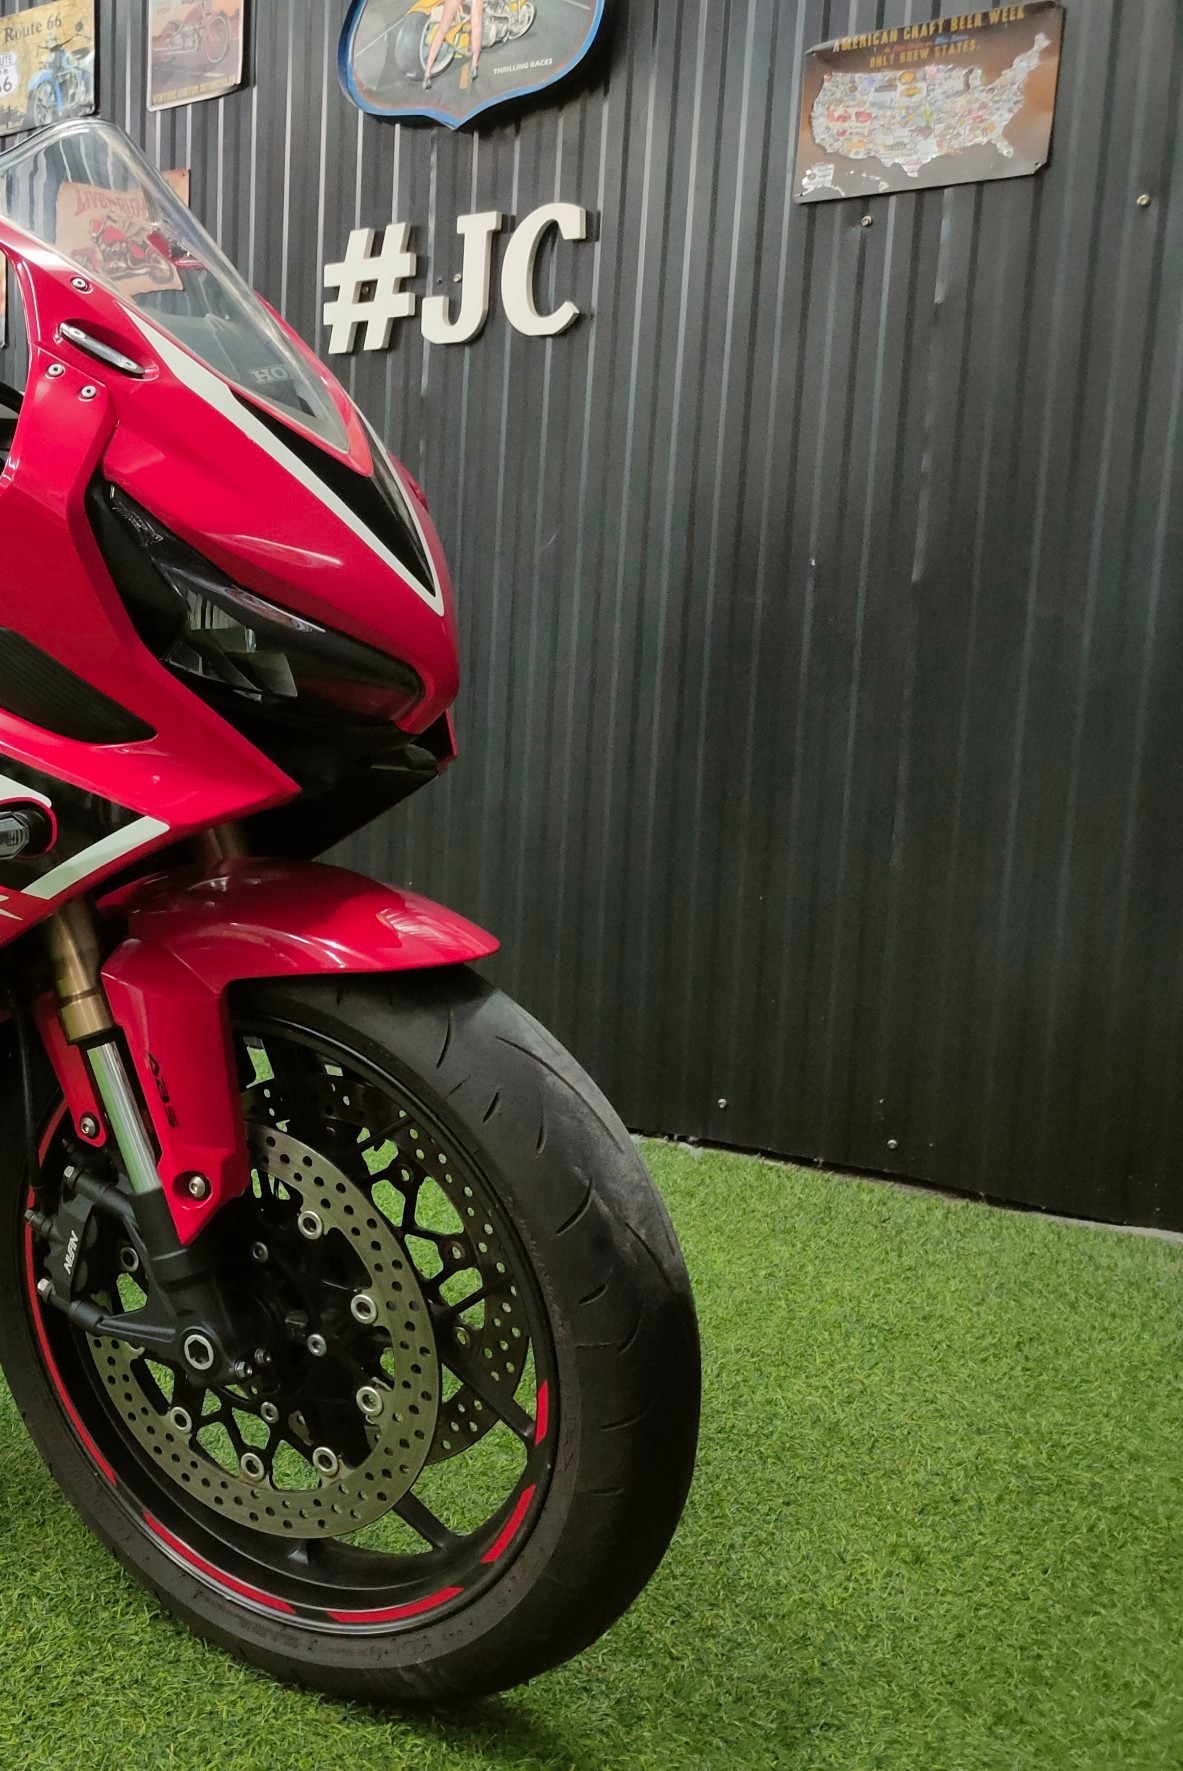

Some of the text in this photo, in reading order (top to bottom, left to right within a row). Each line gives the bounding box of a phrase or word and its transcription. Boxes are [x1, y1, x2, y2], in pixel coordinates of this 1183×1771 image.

[4, 21, 43, 43] Route
[46, 12, 62, 30] 66
[833, 28, 898, 53] AMERICAN
[903, 20, 945, 41] CRAFT
[950, 13, 982, 33] BEER
[989, 5, 1025, 24] WEEK
[494, 58, 553, 75] THRILLING RACES
[323, 202, 587, 355] #JC
[147, 1052, 179, 1129] ABS
